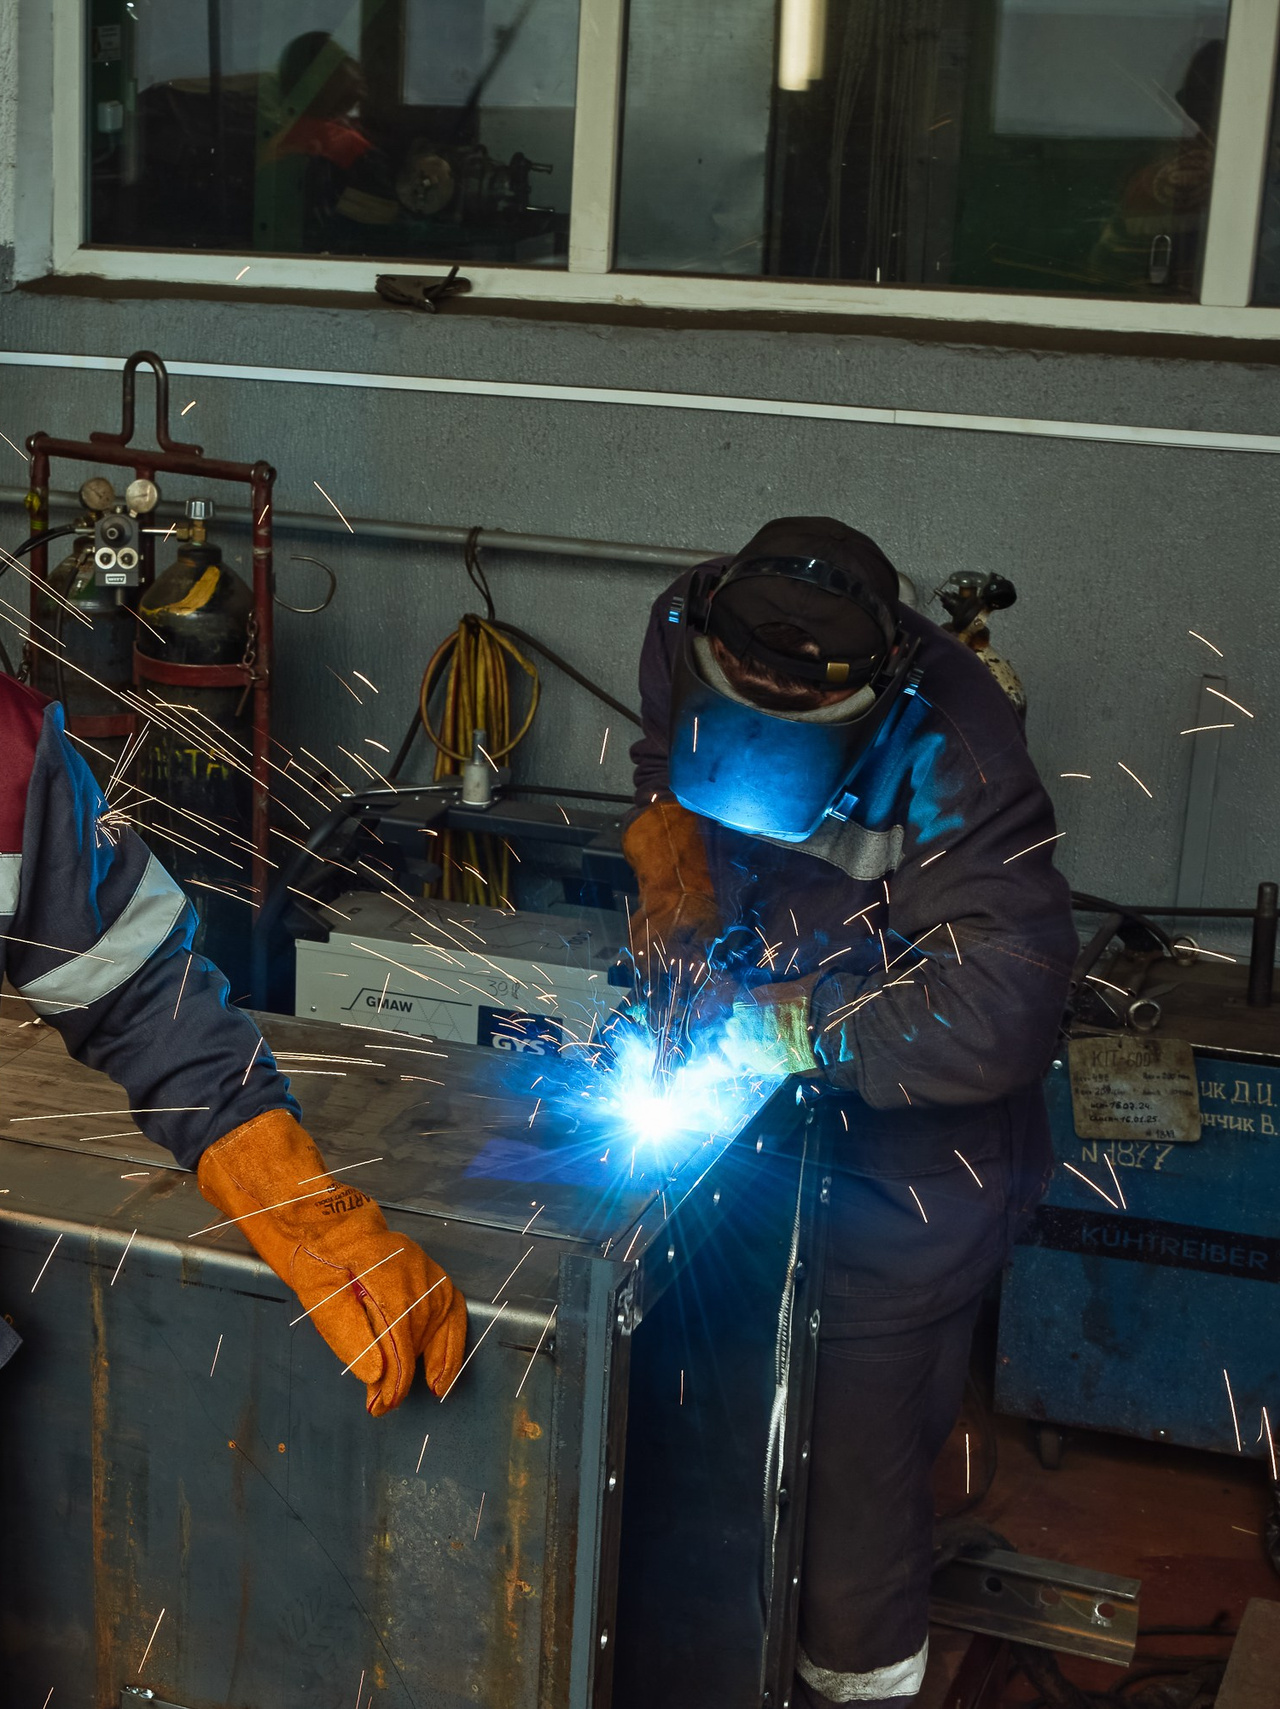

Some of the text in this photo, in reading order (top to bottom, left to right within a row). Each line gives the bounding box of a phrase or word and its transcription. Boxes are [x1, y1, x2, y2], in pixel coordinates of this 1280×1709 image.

[366, 995, 413, 1014] GMAW
[492, 1034, 546, 1056] GYS
[1200, 1080, 1226, 1099] ик
